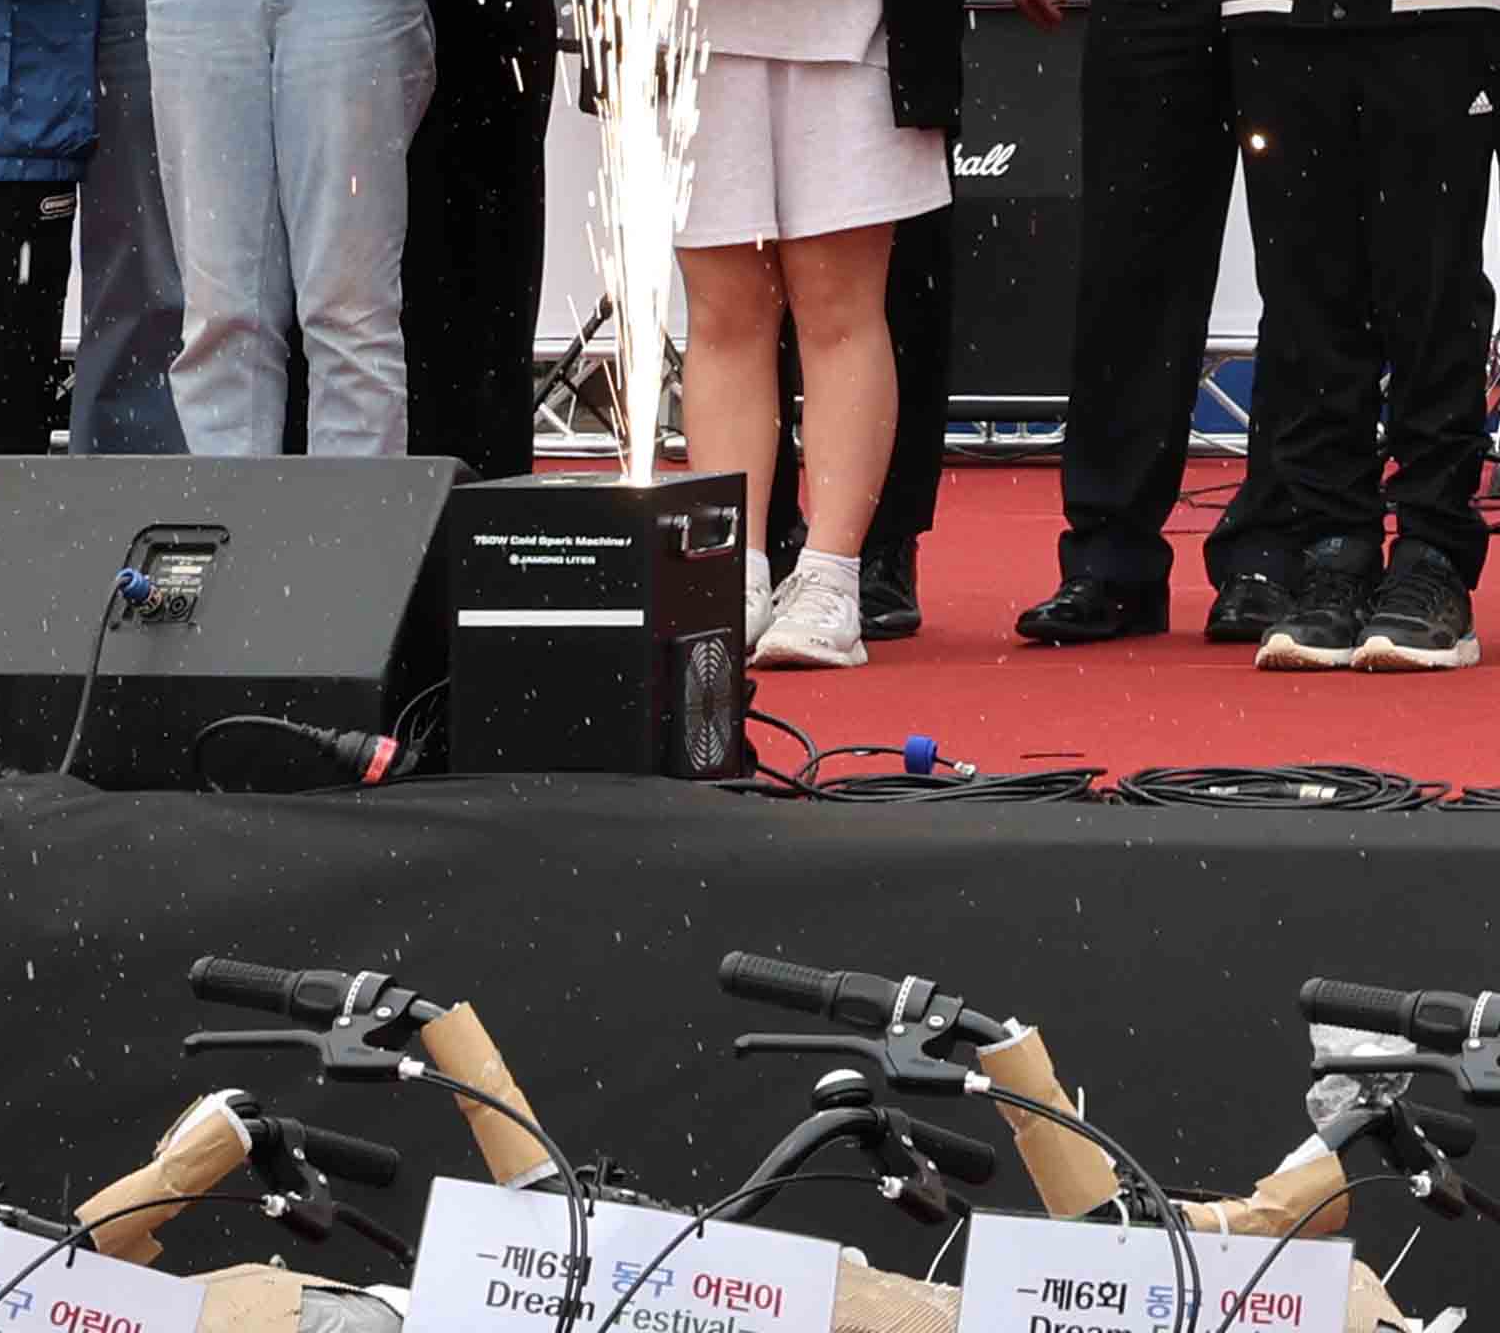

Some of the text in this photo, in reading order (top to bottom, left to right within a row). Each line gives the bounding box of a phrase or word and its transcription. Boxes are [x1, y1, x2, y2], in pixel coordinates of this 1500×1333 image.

[612, 1260, 675, 1298] 동구
[693, 1273, 784, 1317] 어린이
[1220, 1290, 1302, 1326] 어린이
